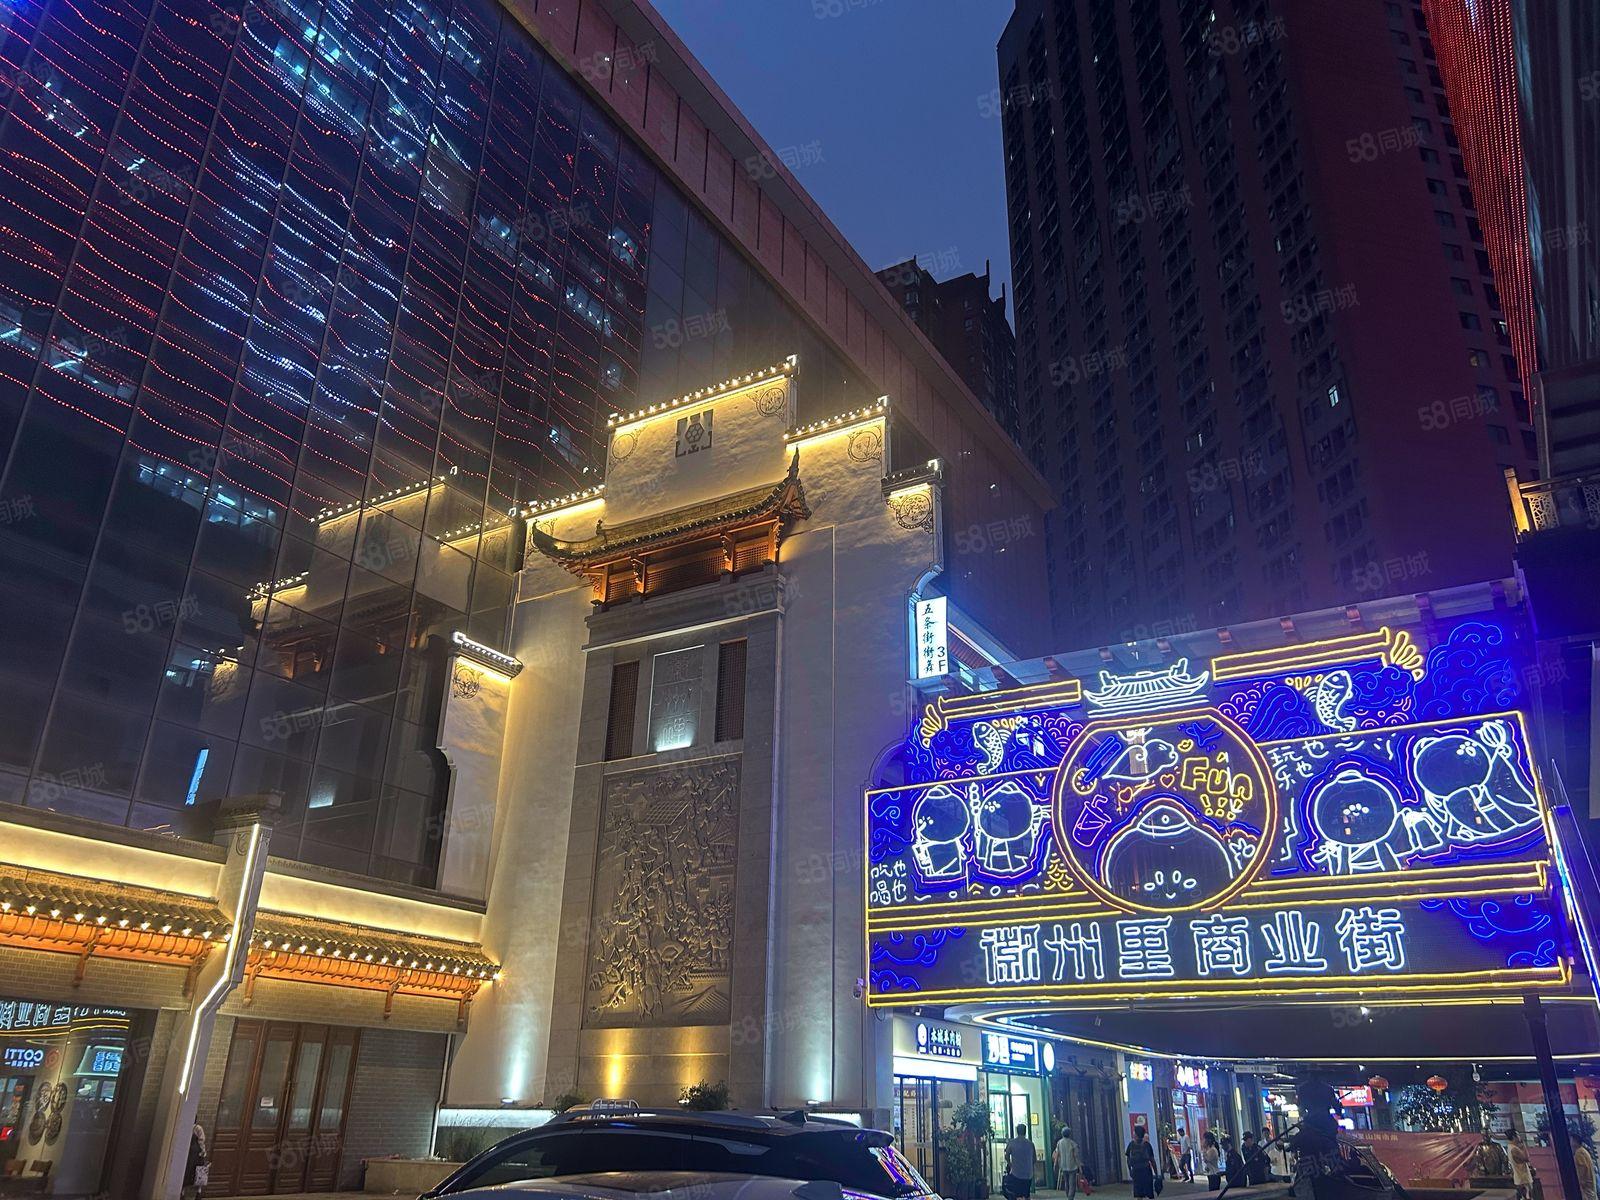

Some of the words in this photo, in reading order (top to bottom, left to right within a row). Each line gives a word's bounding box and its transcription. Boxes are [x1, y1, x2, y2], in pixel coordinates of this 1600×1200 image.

[937, 646, 946, 672] 3F
[980, 907, 1405, 984] 徽州里商业街
